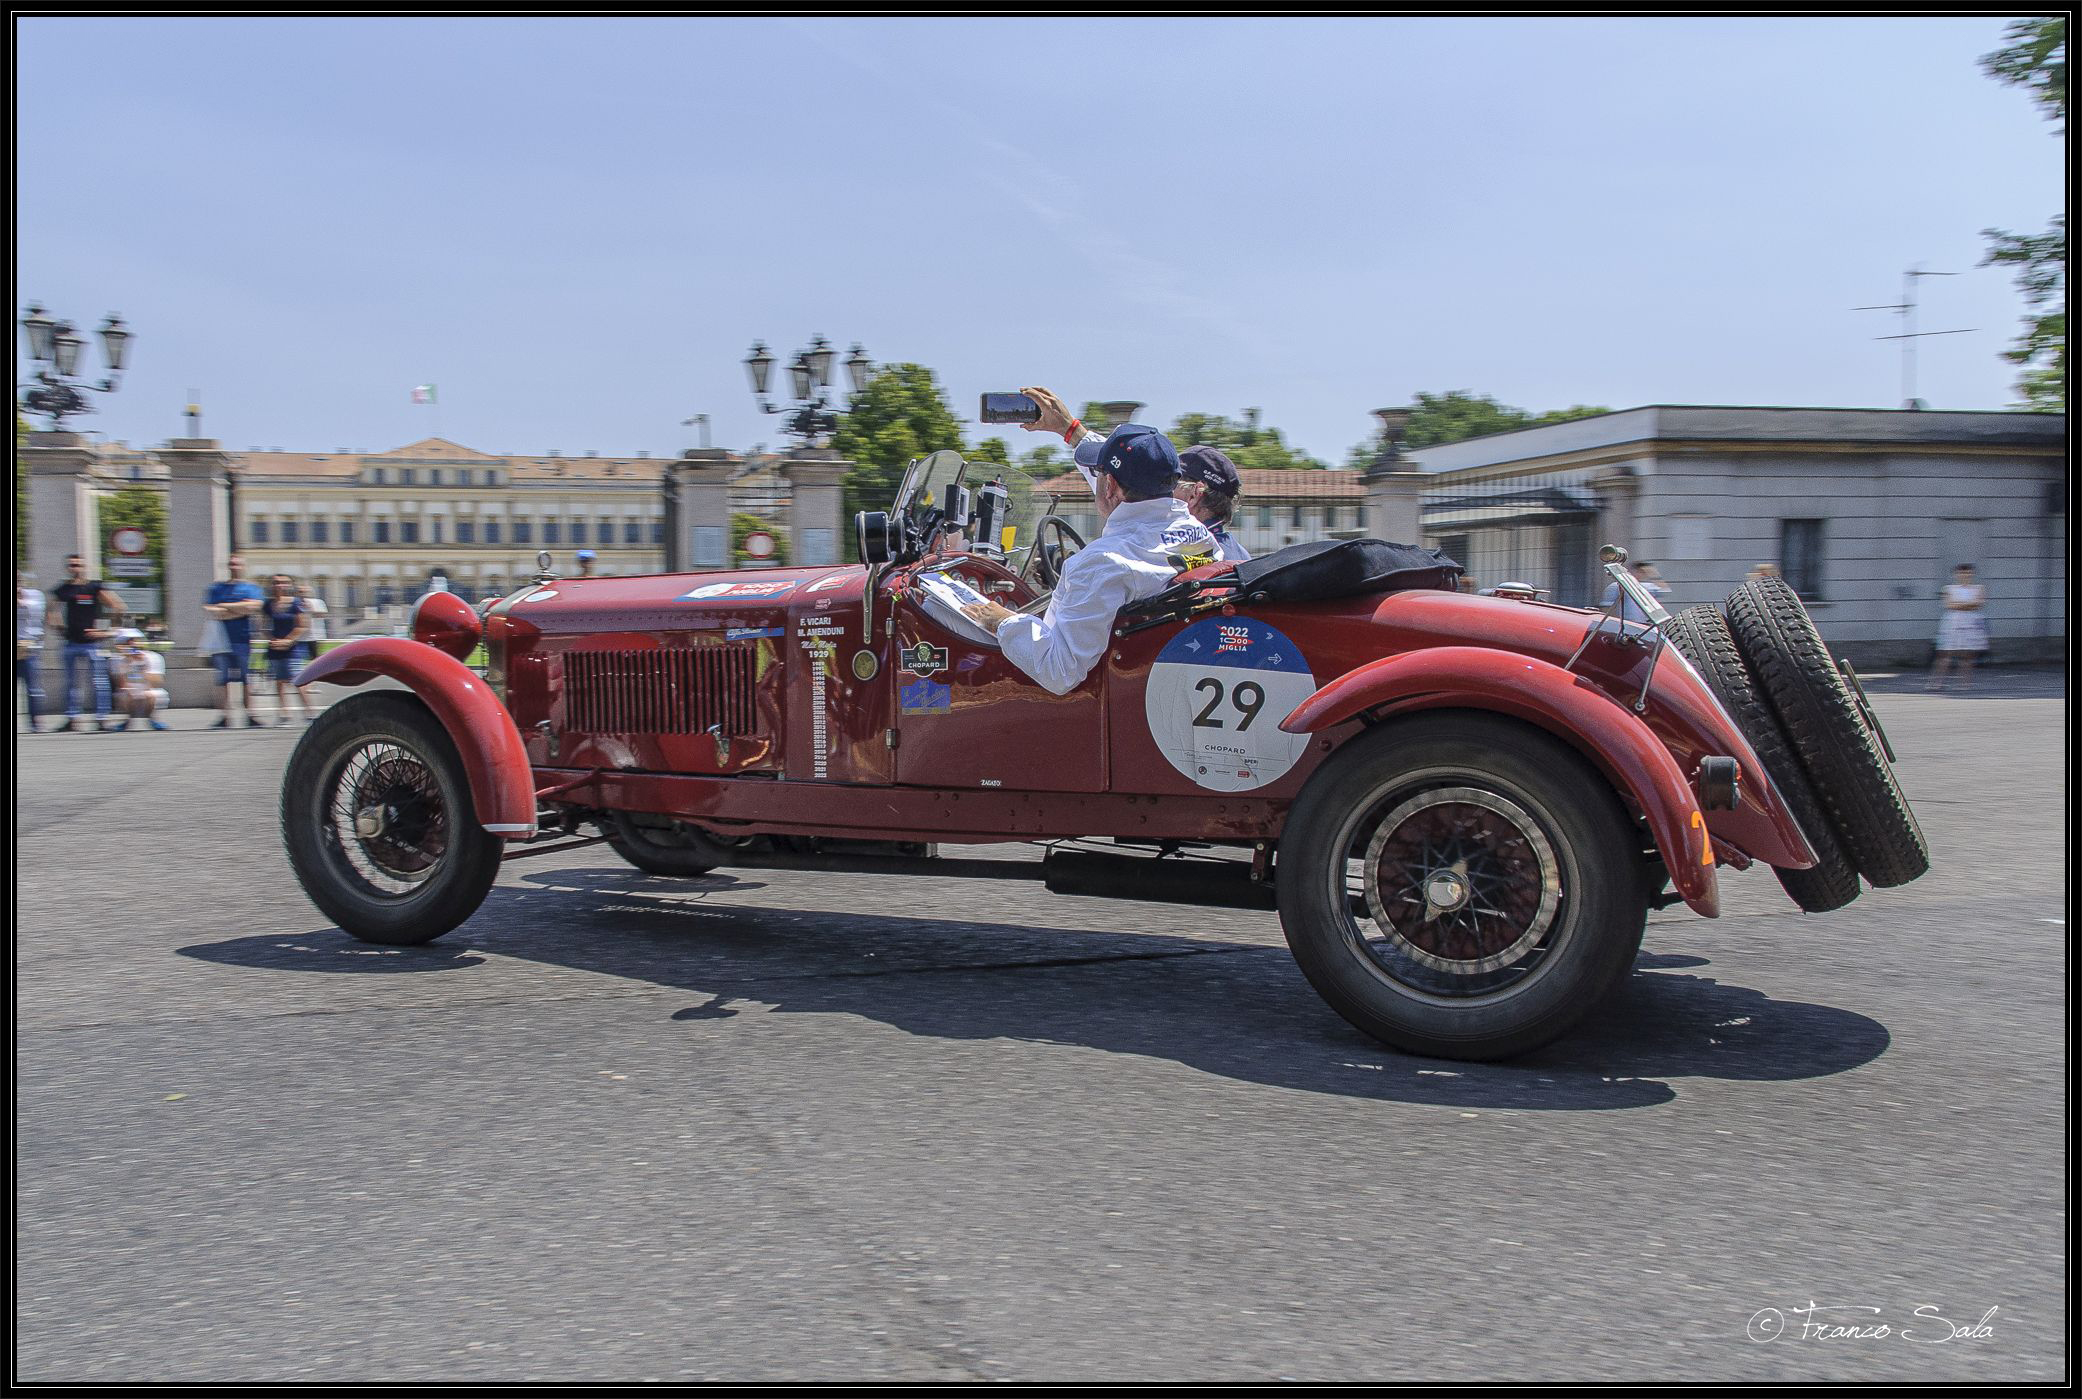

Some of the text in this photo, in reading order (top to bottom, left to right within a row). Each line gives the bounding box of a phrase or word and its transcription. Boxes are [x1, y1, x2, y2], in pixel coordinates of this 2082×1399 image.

[1110, 455, 1121, 469] 29
[806, 616, 832, 626] VICARI
[806, 626, 845, 637] AMENDUNI
[1220, 625, 1249, 638] 2022
[1219, 637, 1248, 645] 1000
[1218, 644, 1248, 652] MIGLIA
[808, 650, 829, 658] 1929
[1192, 677, 1266, 732] 29
[1204, 744, 1246, 755] CHOPARD
